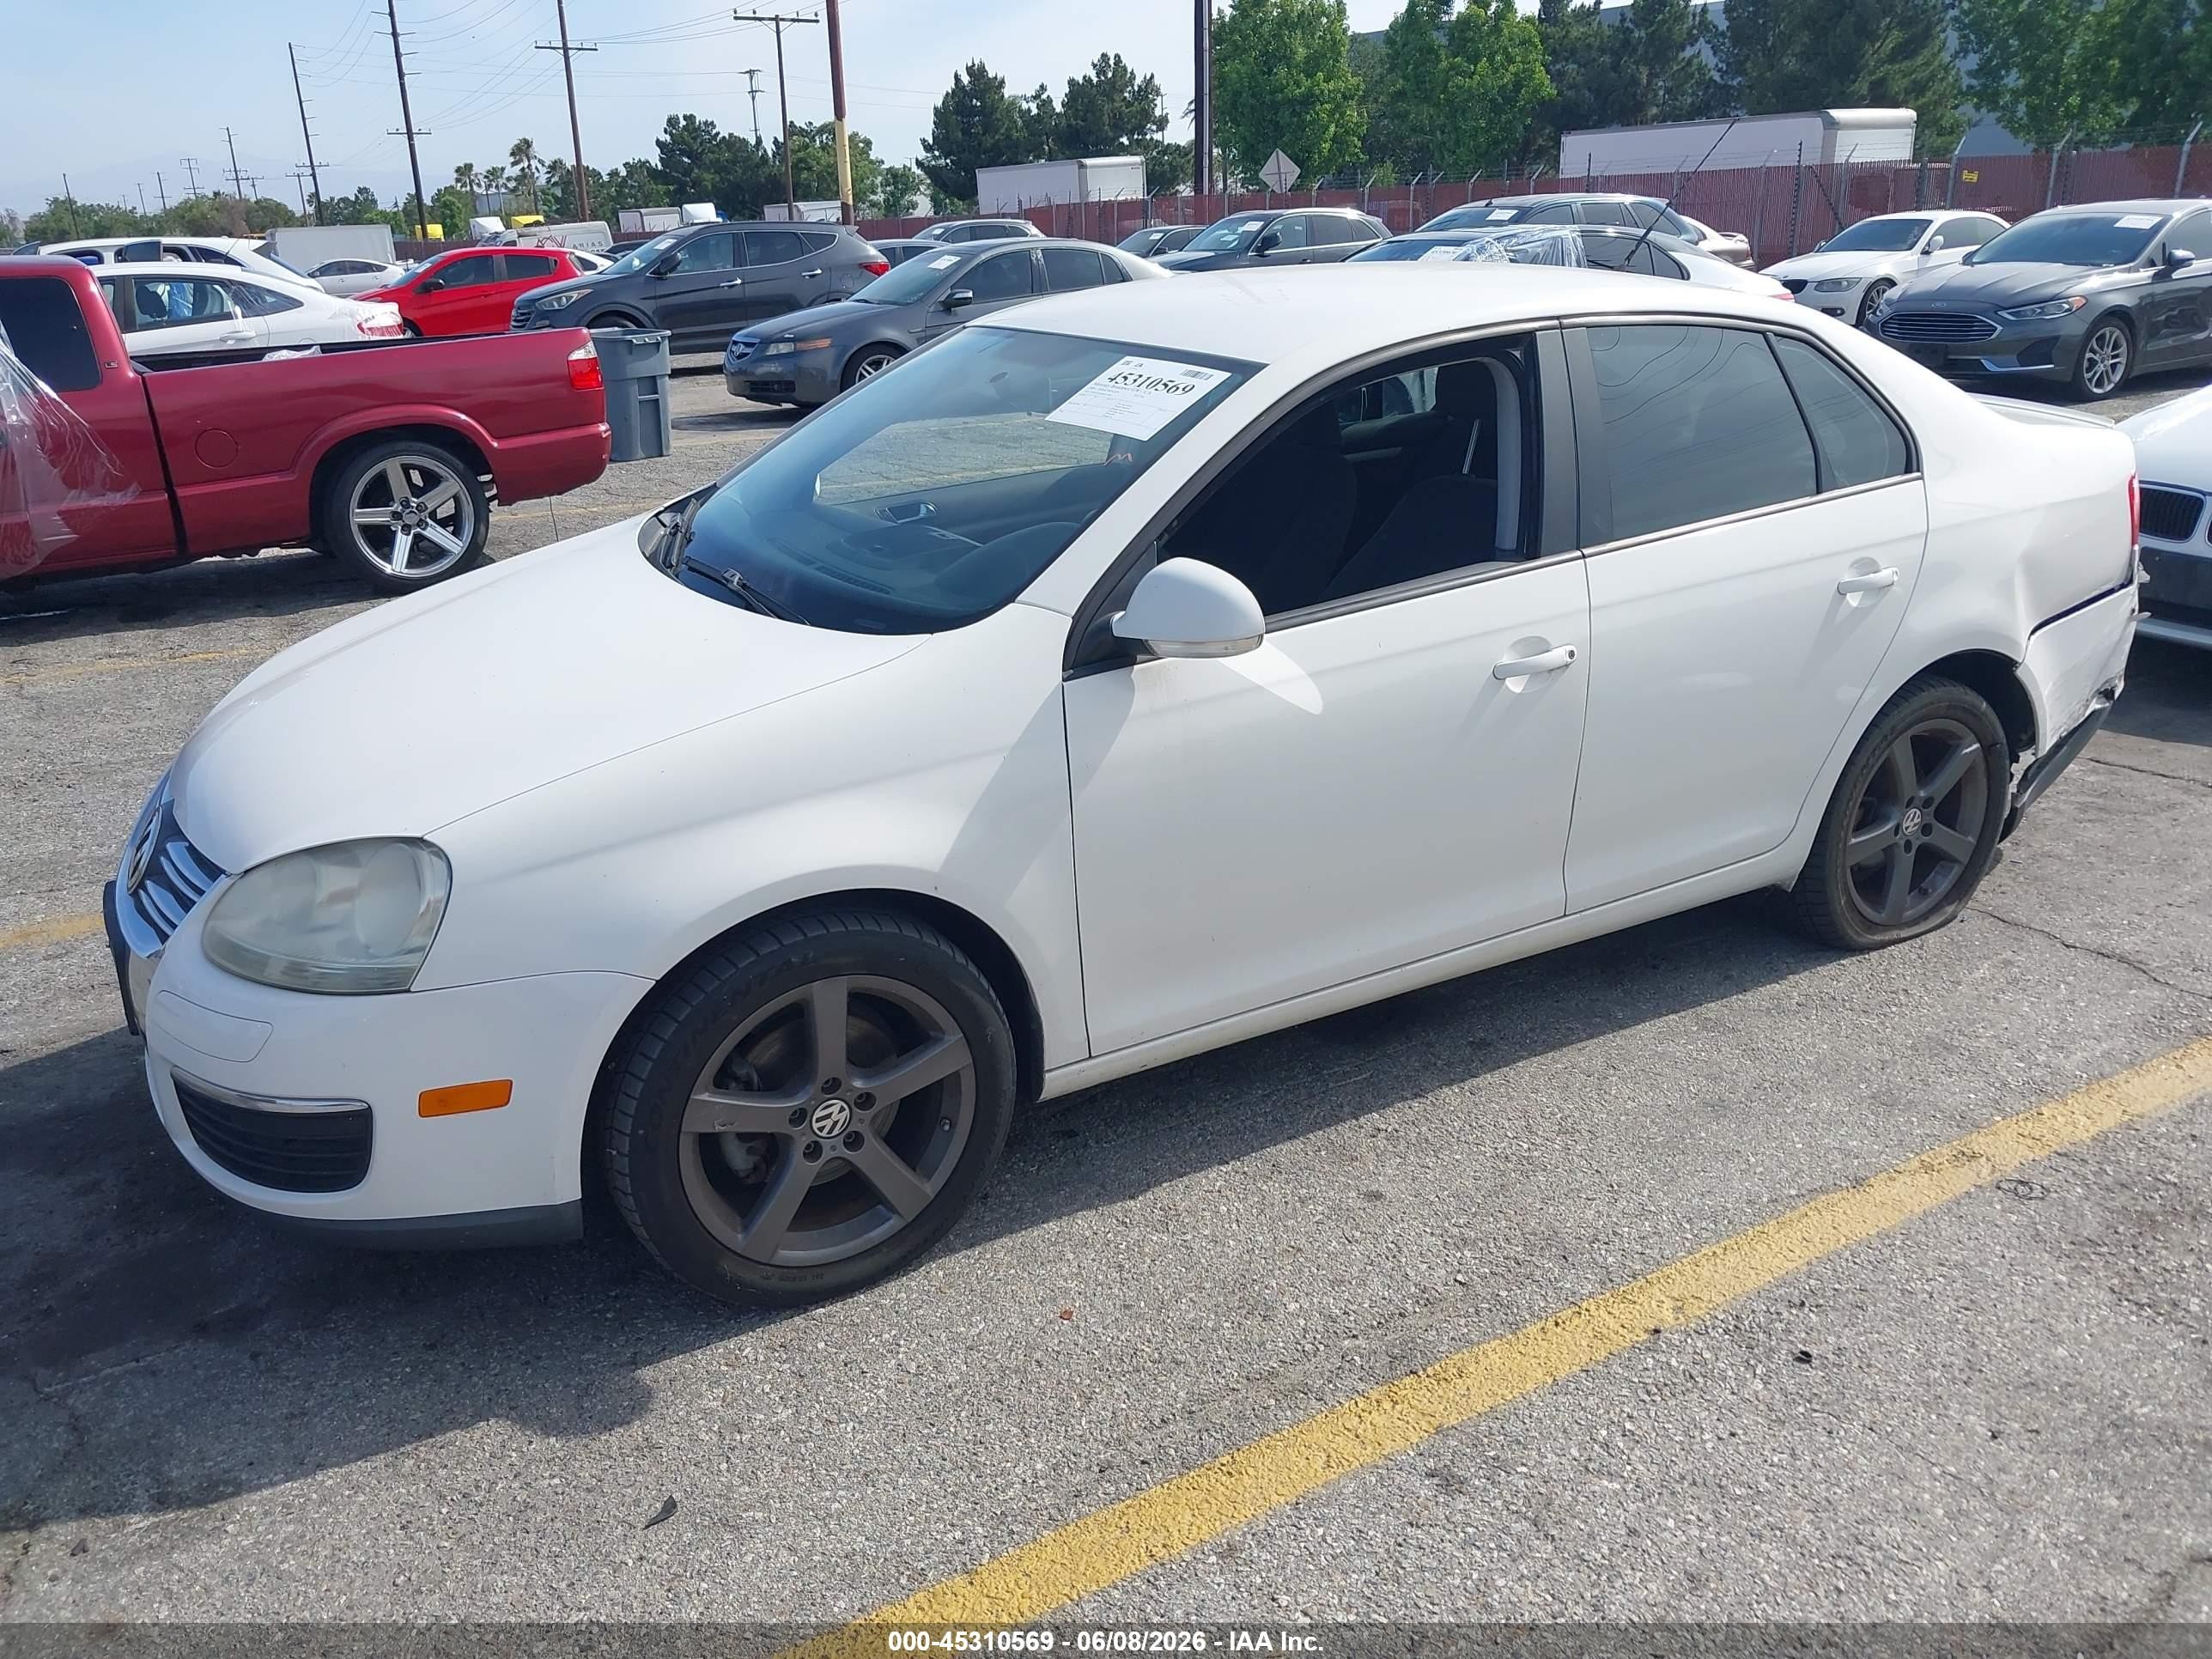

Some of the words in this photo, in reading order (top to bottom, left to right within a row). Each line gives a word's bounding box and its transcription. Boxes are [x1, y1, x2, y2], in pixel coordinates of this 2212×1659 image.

[572, 240, 604, 250] ARIAS
[104, 361, 118, 369] LS
[1107, 371, 1196, 397] 45310569
